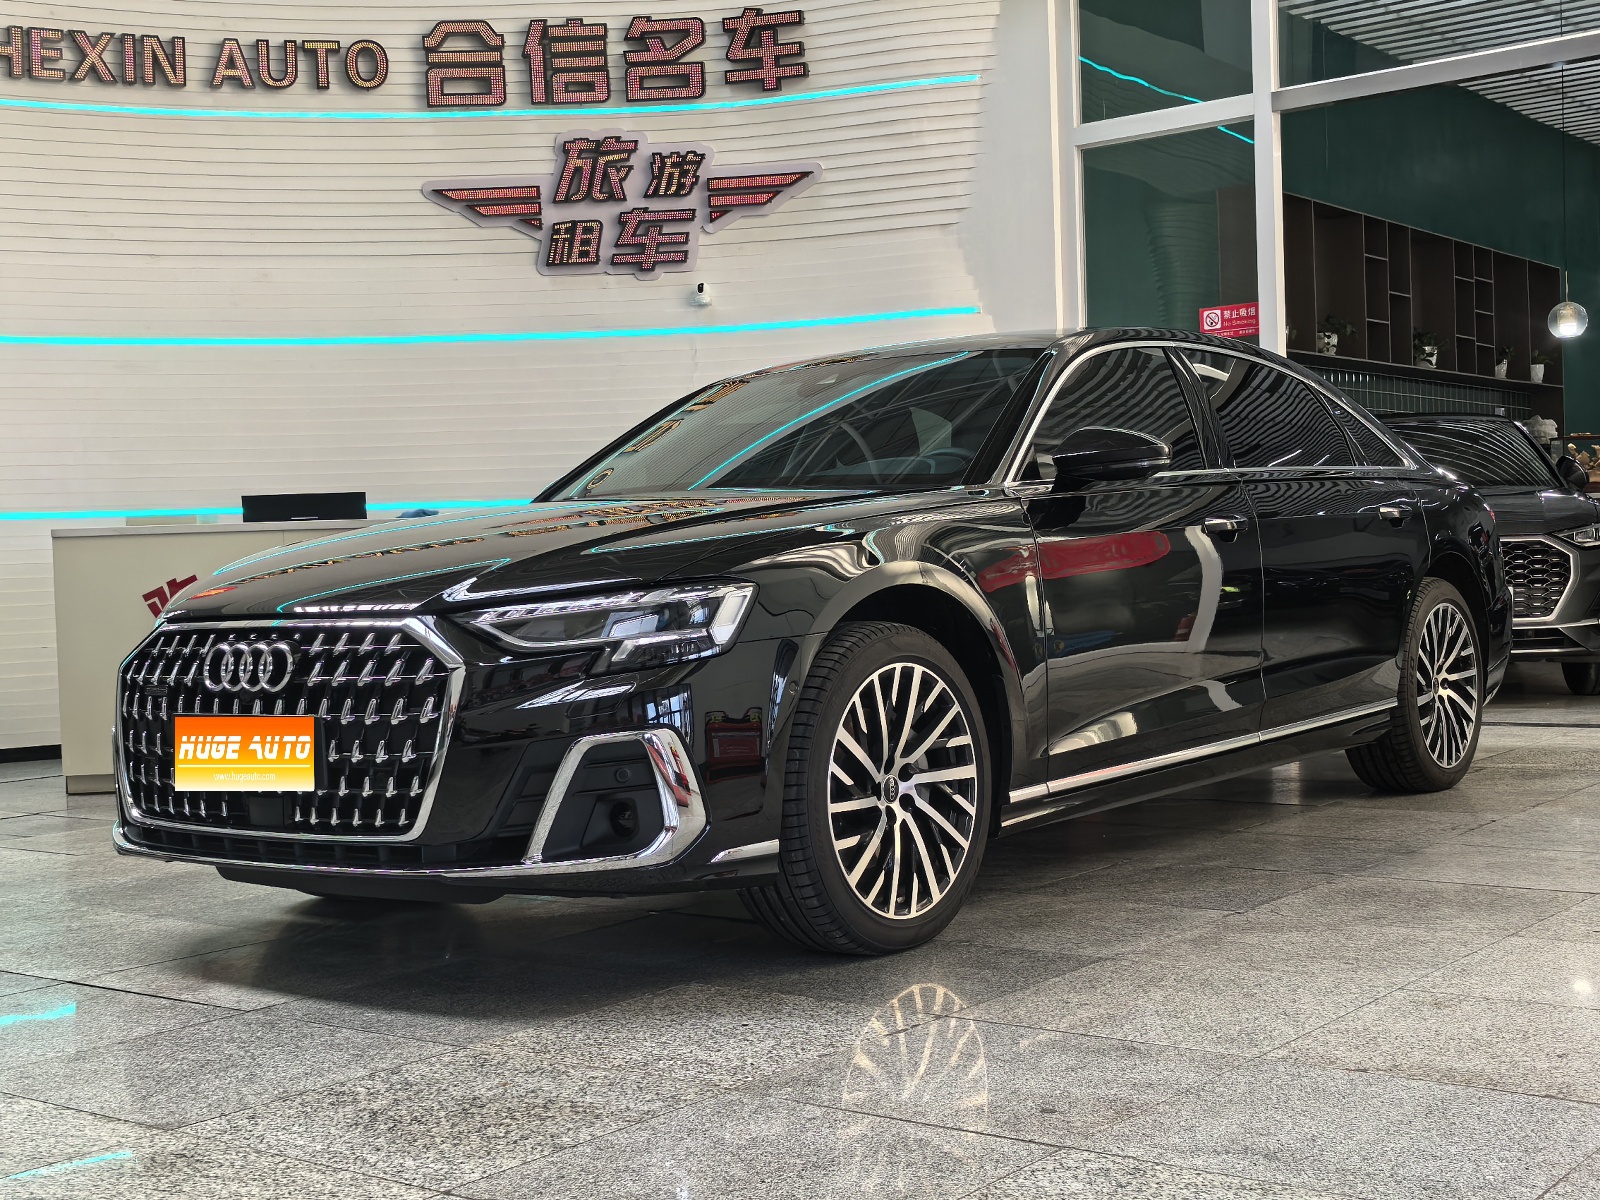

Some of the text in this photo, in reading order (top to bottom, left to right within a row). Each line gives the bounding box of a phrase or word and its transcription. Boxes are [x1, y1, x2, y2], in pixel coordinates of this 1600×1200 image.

[0, 25, 389, 90] HEXIN AUTO
[422, 8, 809, 107] 合信名车
[553, 136, 706, 203] 旅游
[546, 208, 697, 271] 租车
[1223, 307, 1256, 320] 禁止吸烟
